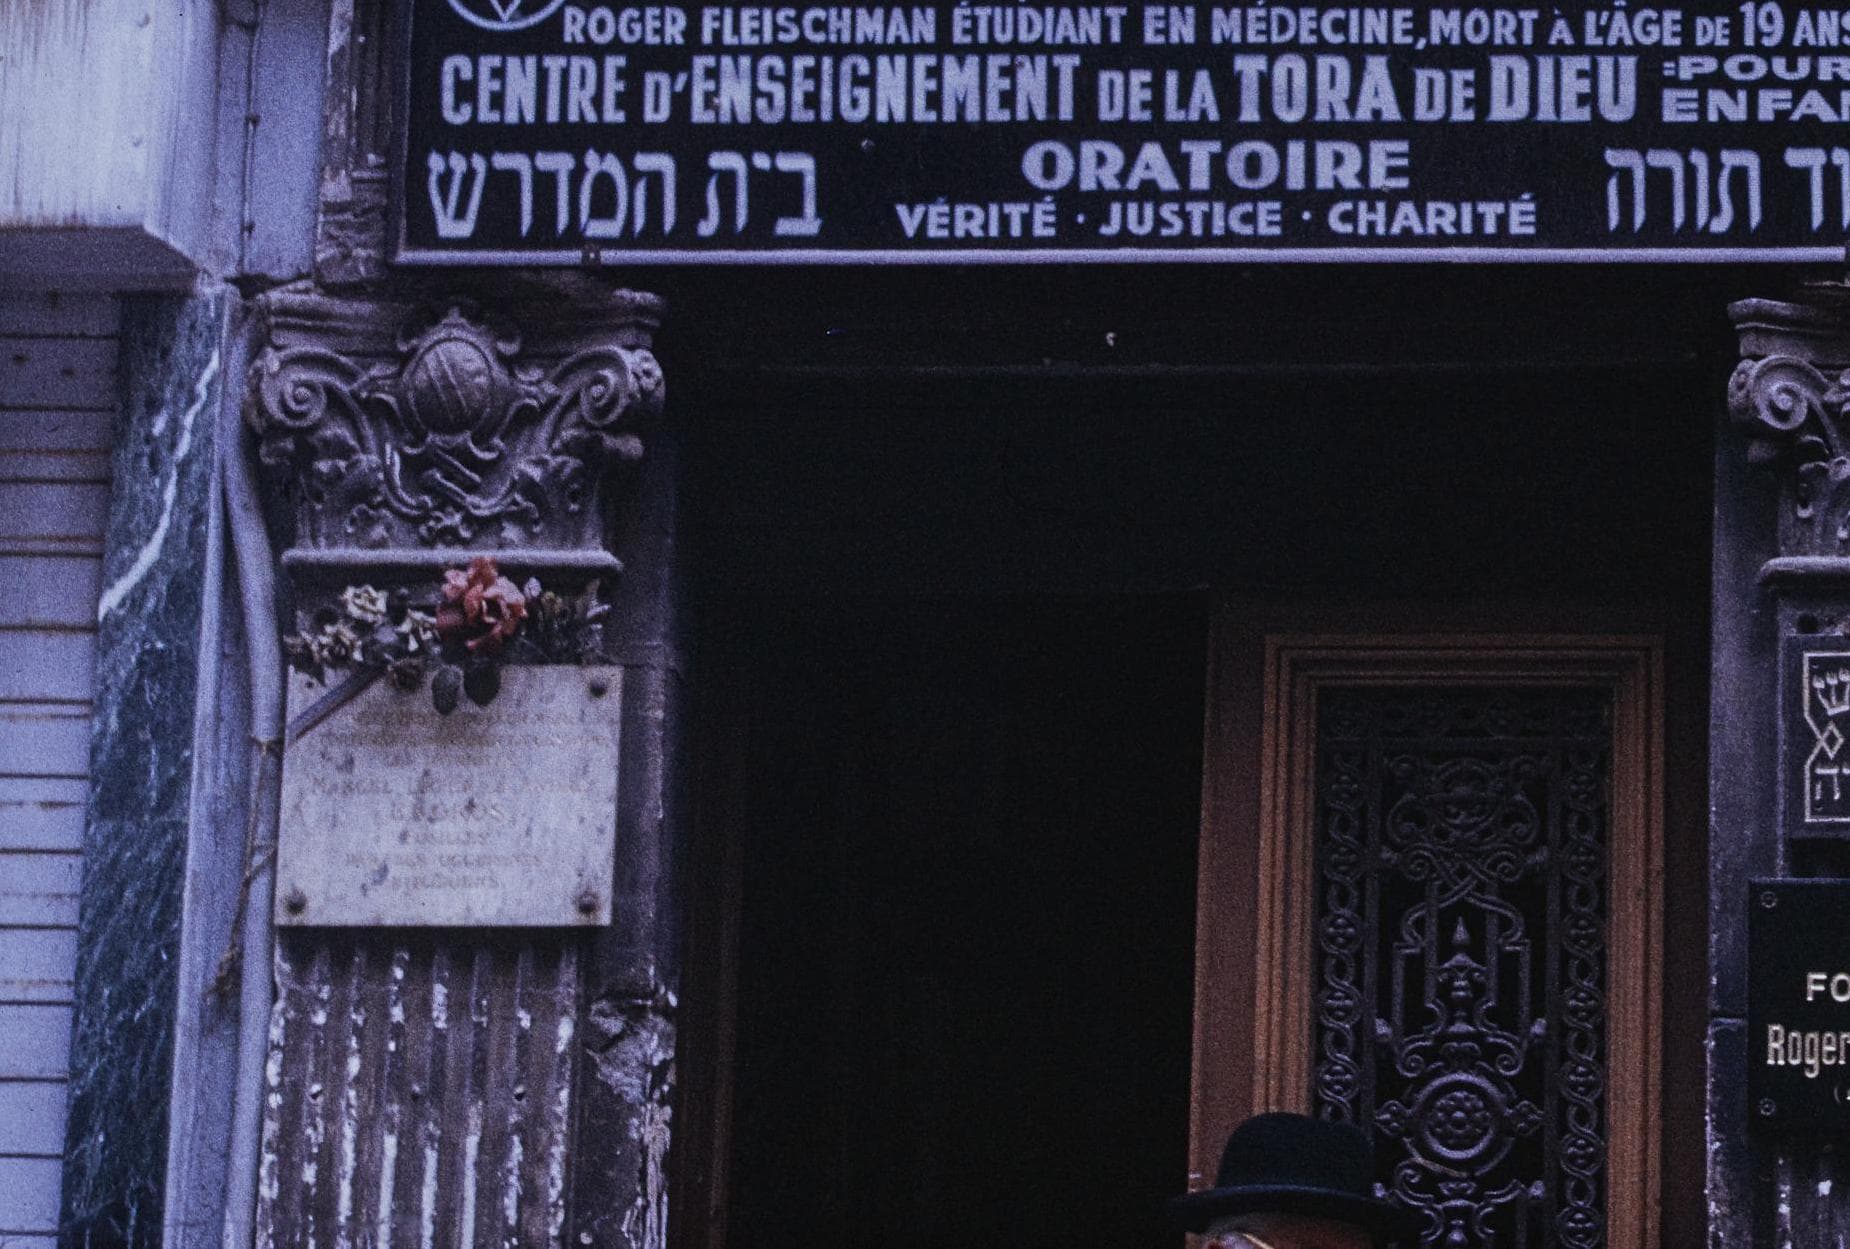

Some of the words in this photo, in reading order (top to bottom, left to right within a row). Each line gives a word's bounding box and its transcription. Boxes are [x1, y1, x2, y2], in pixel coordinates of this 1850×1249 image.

[563, 5, 687, 45] ROGER
[701, 7, 936, 46] FLEISCHMAN
[952, 0, 1127, 46] ÉTUDIANT
[1143, 5, 1196, 45] EN
[1430, 7, 1540, 46] MORT
[1548, 7, 1575, 46] À
[1695, 16, 1730, 46] DE
[1739, 1, 1785, 47] 19
[440, 54, 628, 126] CENTRE
[1097, 69, 1153, 122] DE
[1165, 69, 1220, 122] LA
[1233, 53, 1403, 123] TORA
[1413, 68, 1475, 122] DE
[1486, 54, 1638, 123] DIEU
[427, 149, 677, 239] המדרש
[696, 149, 824, 238] בית
[1021, 139, 1410, 192] ORATOIRE
[1604, 146, 1763, 234] תורה
[895, 195, 1057, 239] VÉRITÉ
[1098, 200, 1282, 237] JUSTICE
[1327, 192, 1537, 237] CHARITÉ
